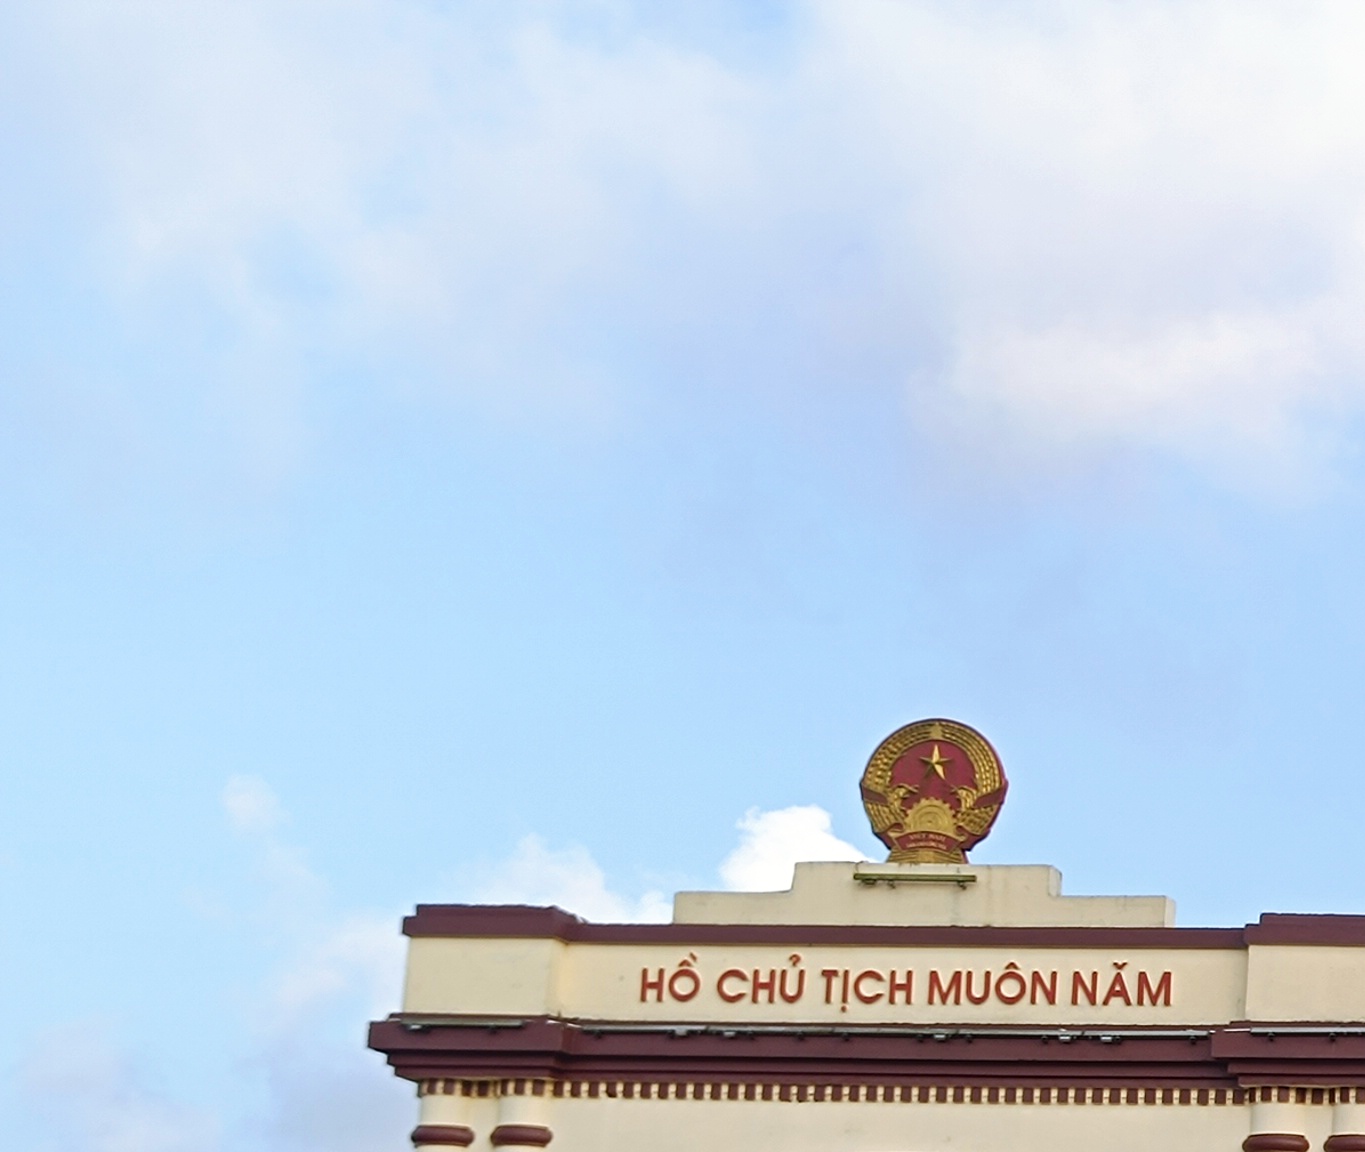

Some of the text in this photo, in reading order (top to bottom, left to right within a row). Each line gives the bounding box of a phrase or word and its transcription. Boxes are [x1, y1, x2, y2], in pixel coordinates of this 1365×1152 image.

[640, 951, 1173, 1013] HỒ CHỦ TỊCH MUÔN NĂM
